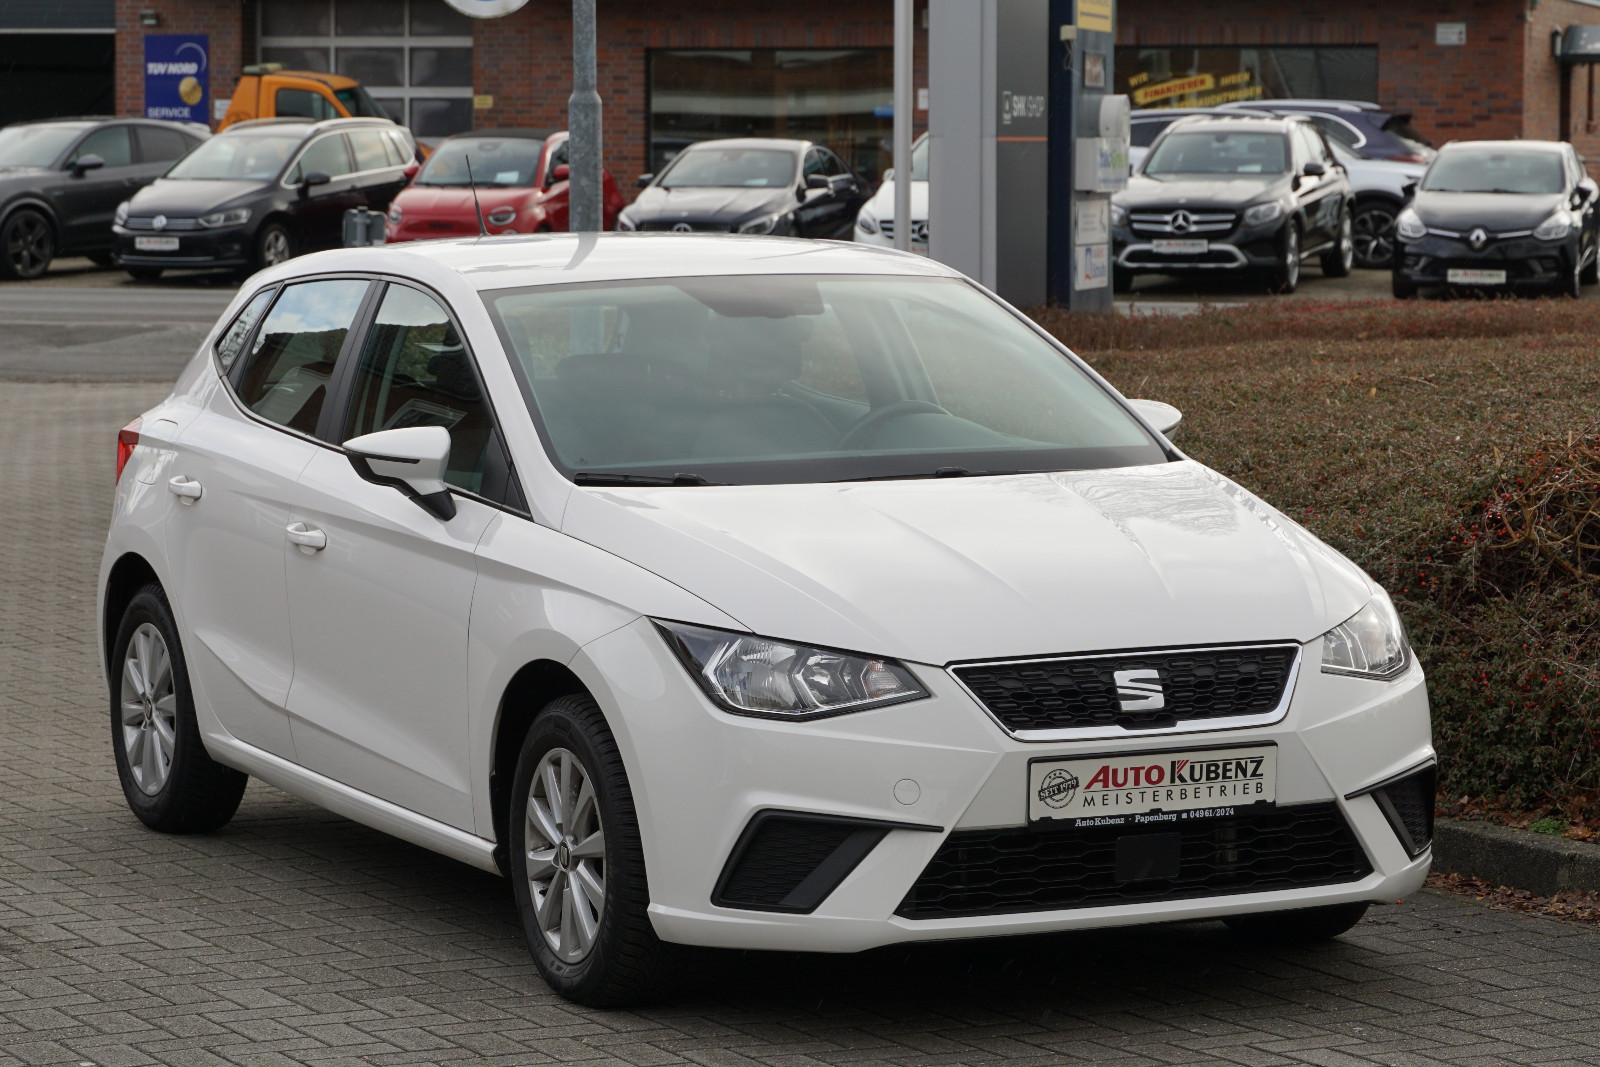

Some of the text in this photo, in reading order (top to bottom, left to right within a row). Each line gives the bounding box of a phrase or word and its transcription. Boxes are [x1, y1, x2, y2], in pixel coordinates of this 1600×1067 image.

[168, 62, 198, 75] NORD
[147, 107, 191, 118] SERVICE
[1084, 764, 1165, 790] AUTO
[1082, 782, 1264, 808] MEISTERBETRIEB
[1135, 813, 1177, 825] Papenburg
